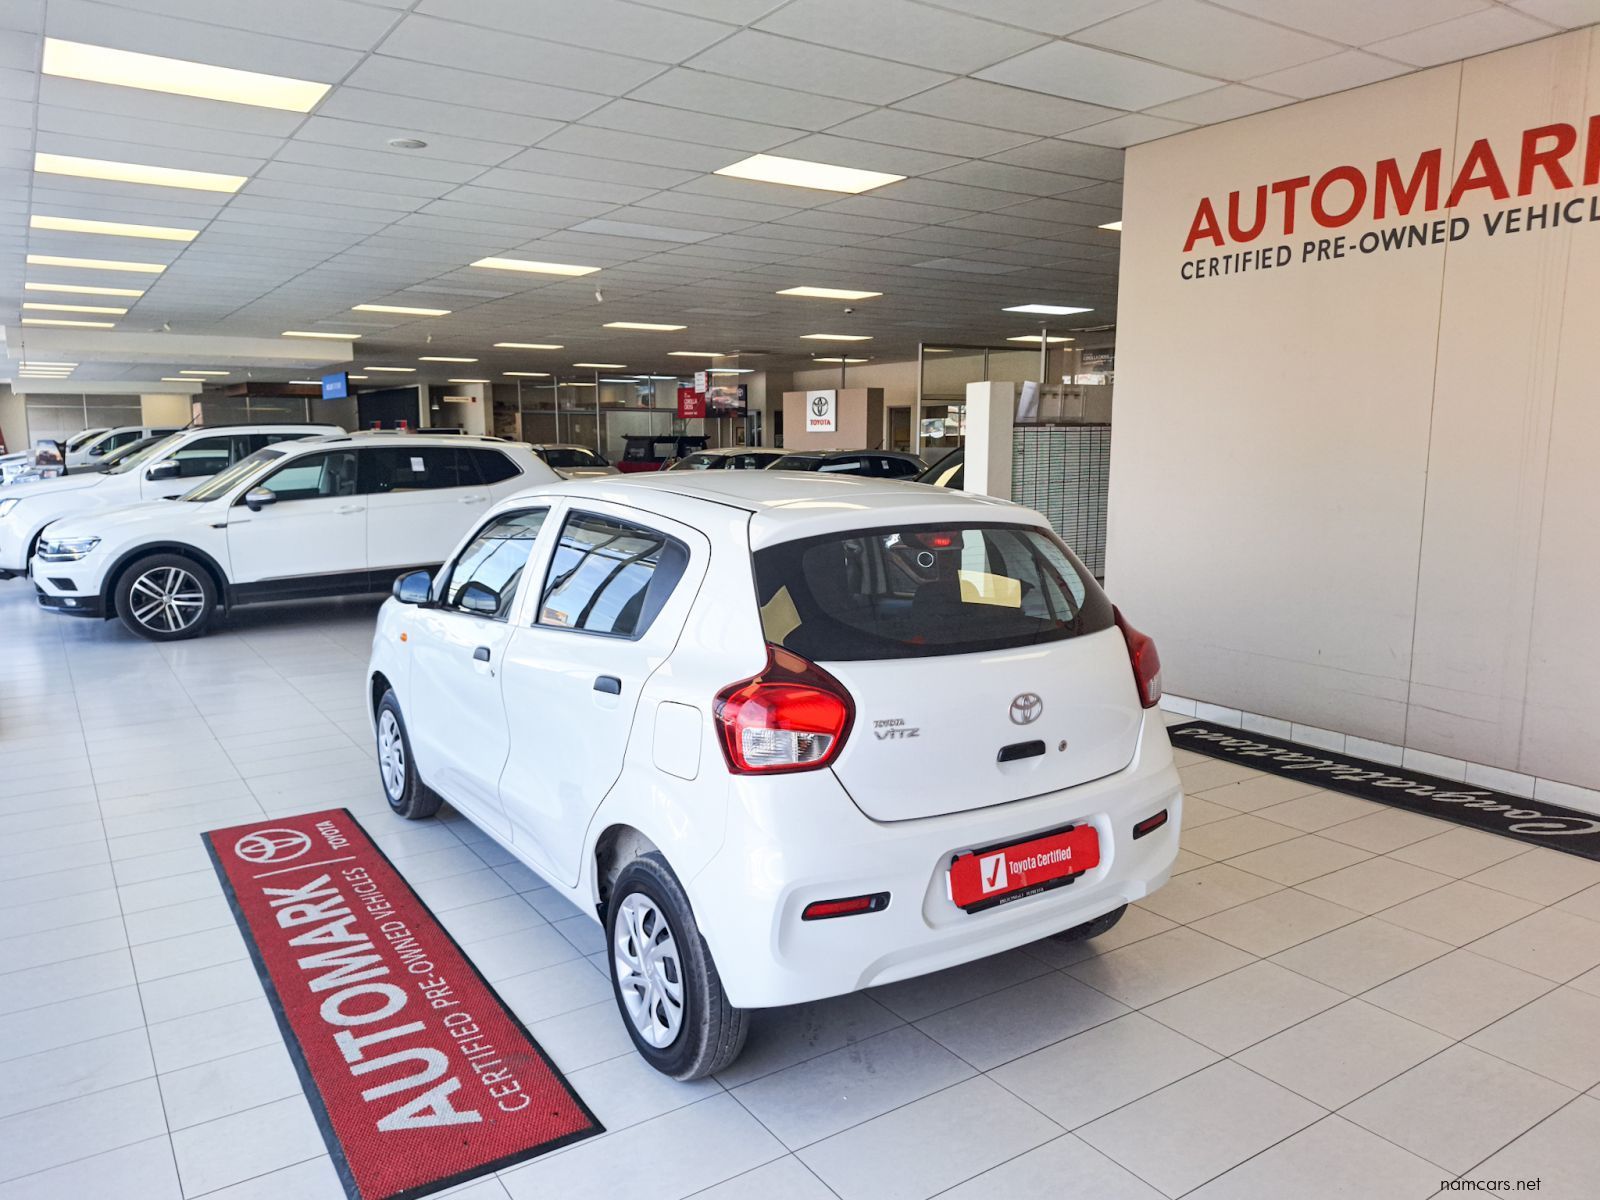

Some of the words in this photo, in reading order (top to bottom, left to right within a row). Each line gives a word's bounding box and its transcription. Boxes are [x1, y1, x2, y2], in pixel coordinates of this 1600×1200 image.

[1180, 244, 1292, 280] CERTIFIED
[1301, 217, 1470, 263] PRE-OWNED
[873, 718, 905, 728] TOYOTA
[874, 727, 920, 740] VITZ
[1174, 728, 1600, 836] Congratulations
[315, 820, 351, 850] TOYOTA
[1009, 858, 1036, 876] Toyota
[1037, 846, 1072, 866] Certified
[342, 867, 397, 925] VEHICLES
[380, 921, 460, 1010] PRE-OWNED
[261, 873, 483, 1133] AUTOMARK
[443, 1012, 531, 1113] CERTIFIED
